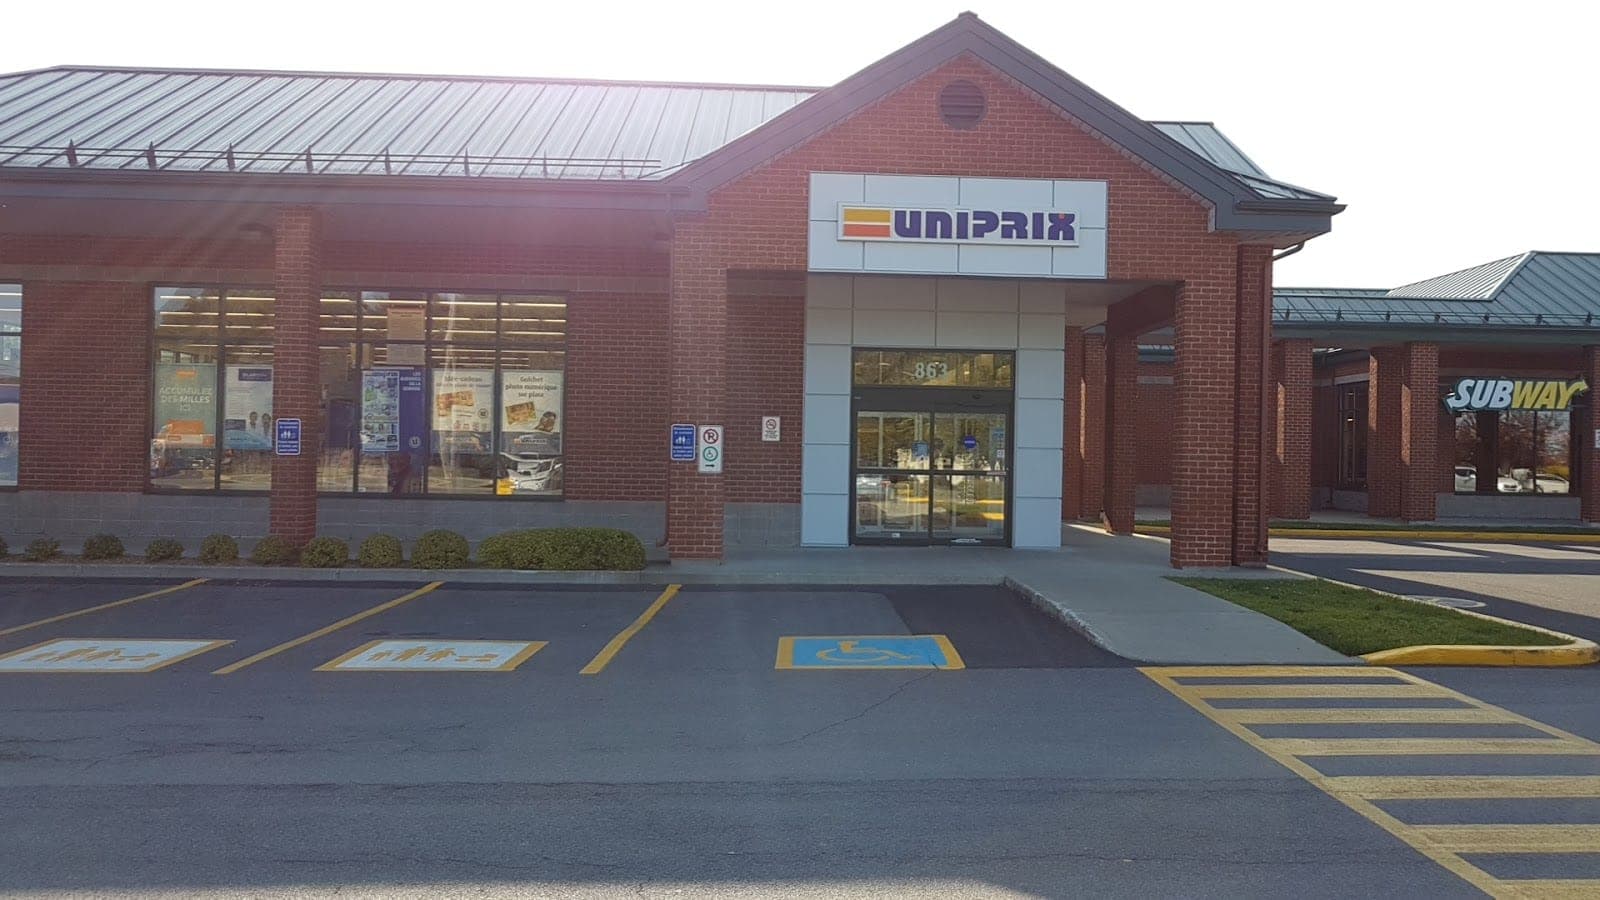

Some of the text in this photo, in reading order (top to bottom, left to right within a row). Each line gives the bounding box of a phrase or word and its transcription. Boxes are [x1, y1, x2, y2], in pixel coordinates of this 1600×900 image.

[894, 209, 1075, 240] UNIPRIX
[915, 363, 948, 380] 863
[1445, 378, 1588, 410] SUBWAY
